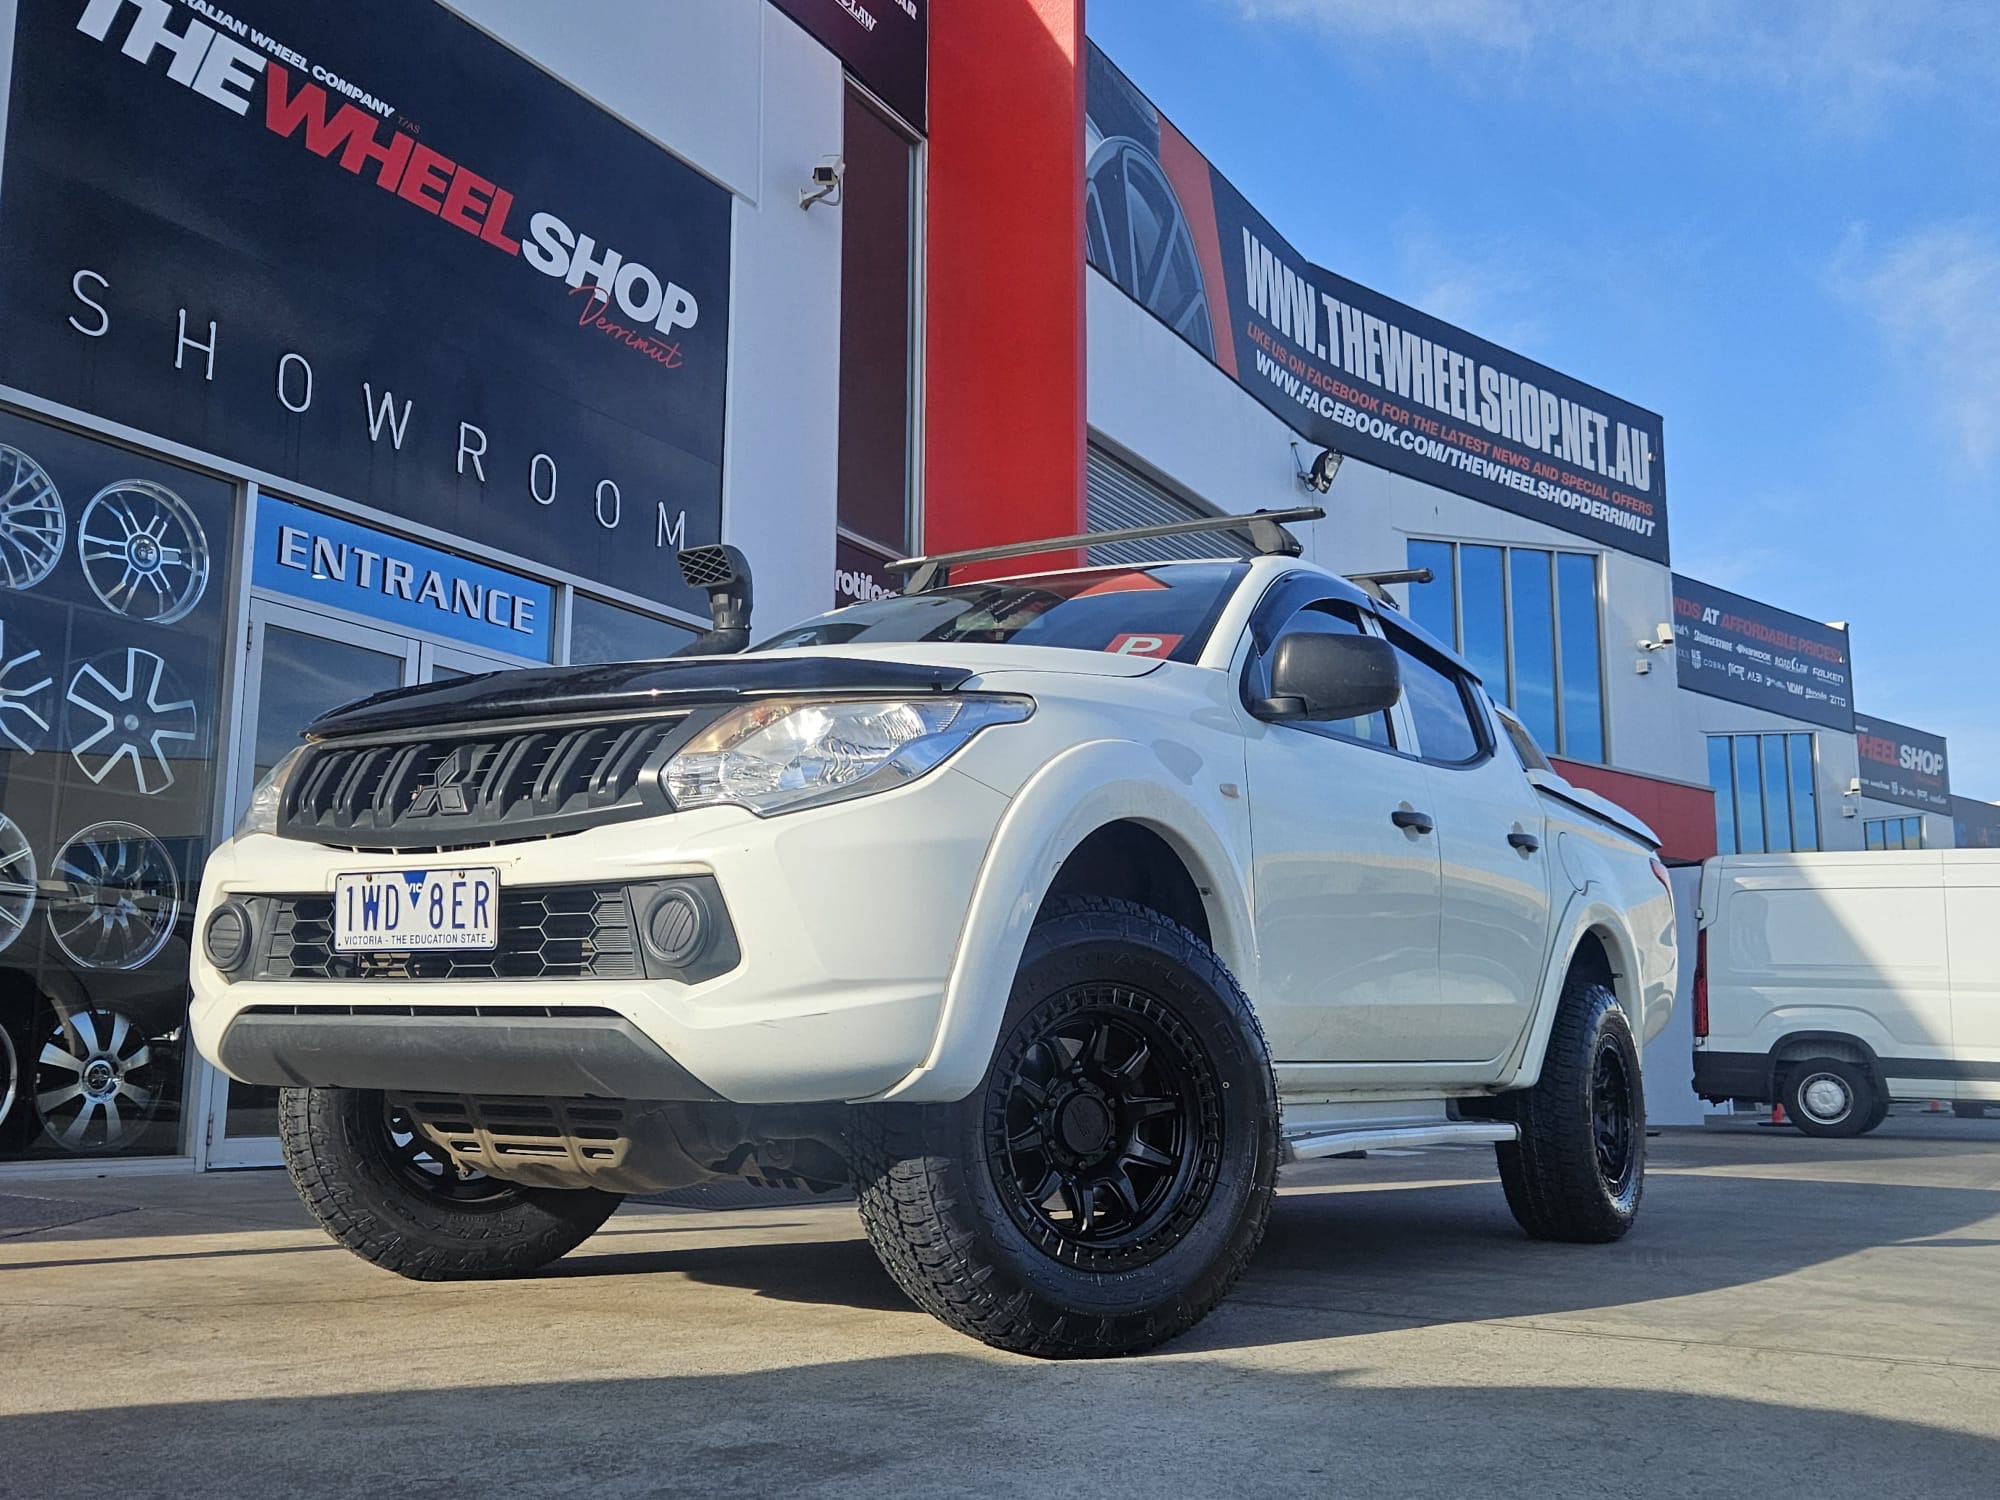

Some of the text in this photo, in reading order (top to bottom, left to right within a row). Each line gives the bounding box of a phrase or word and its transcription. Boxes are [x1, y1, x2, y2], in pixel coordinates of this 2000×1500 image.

[250, 28, 309, 73] WHEEL
[311, 65, 396, 119] COMPANY
[265, 61, 521, 257] WHEEL
[521, 211, 699, 336] SHOP
[1242, 226, 1651, 492] WWW.THEWHEELSHOP.NET.AU
[68, 269, 686, 551] SHOWROOM
[1247, 320, 1654, 516] LIKE US ON FACEBOOK FOR THE LATEST NEWS AND SPECIAL OFFERS
[278, 525, 536, 635] ENTRANCE
[1116, 636, 1163, 655] P
[1702, 606, 1720, 626] AT
[1720, 613, 1799, 650] AFFORDABLE
[1899, 744, 1945, 776] SHOP
[344, 936, 382, 945] VICTORIA
[391, 935, 408, 944] THE
[409, 933, 458, 944] EDUCATION
[460, 933, 487, 943] STATE
[346, 880, 490, 932] 1WD 8ER
